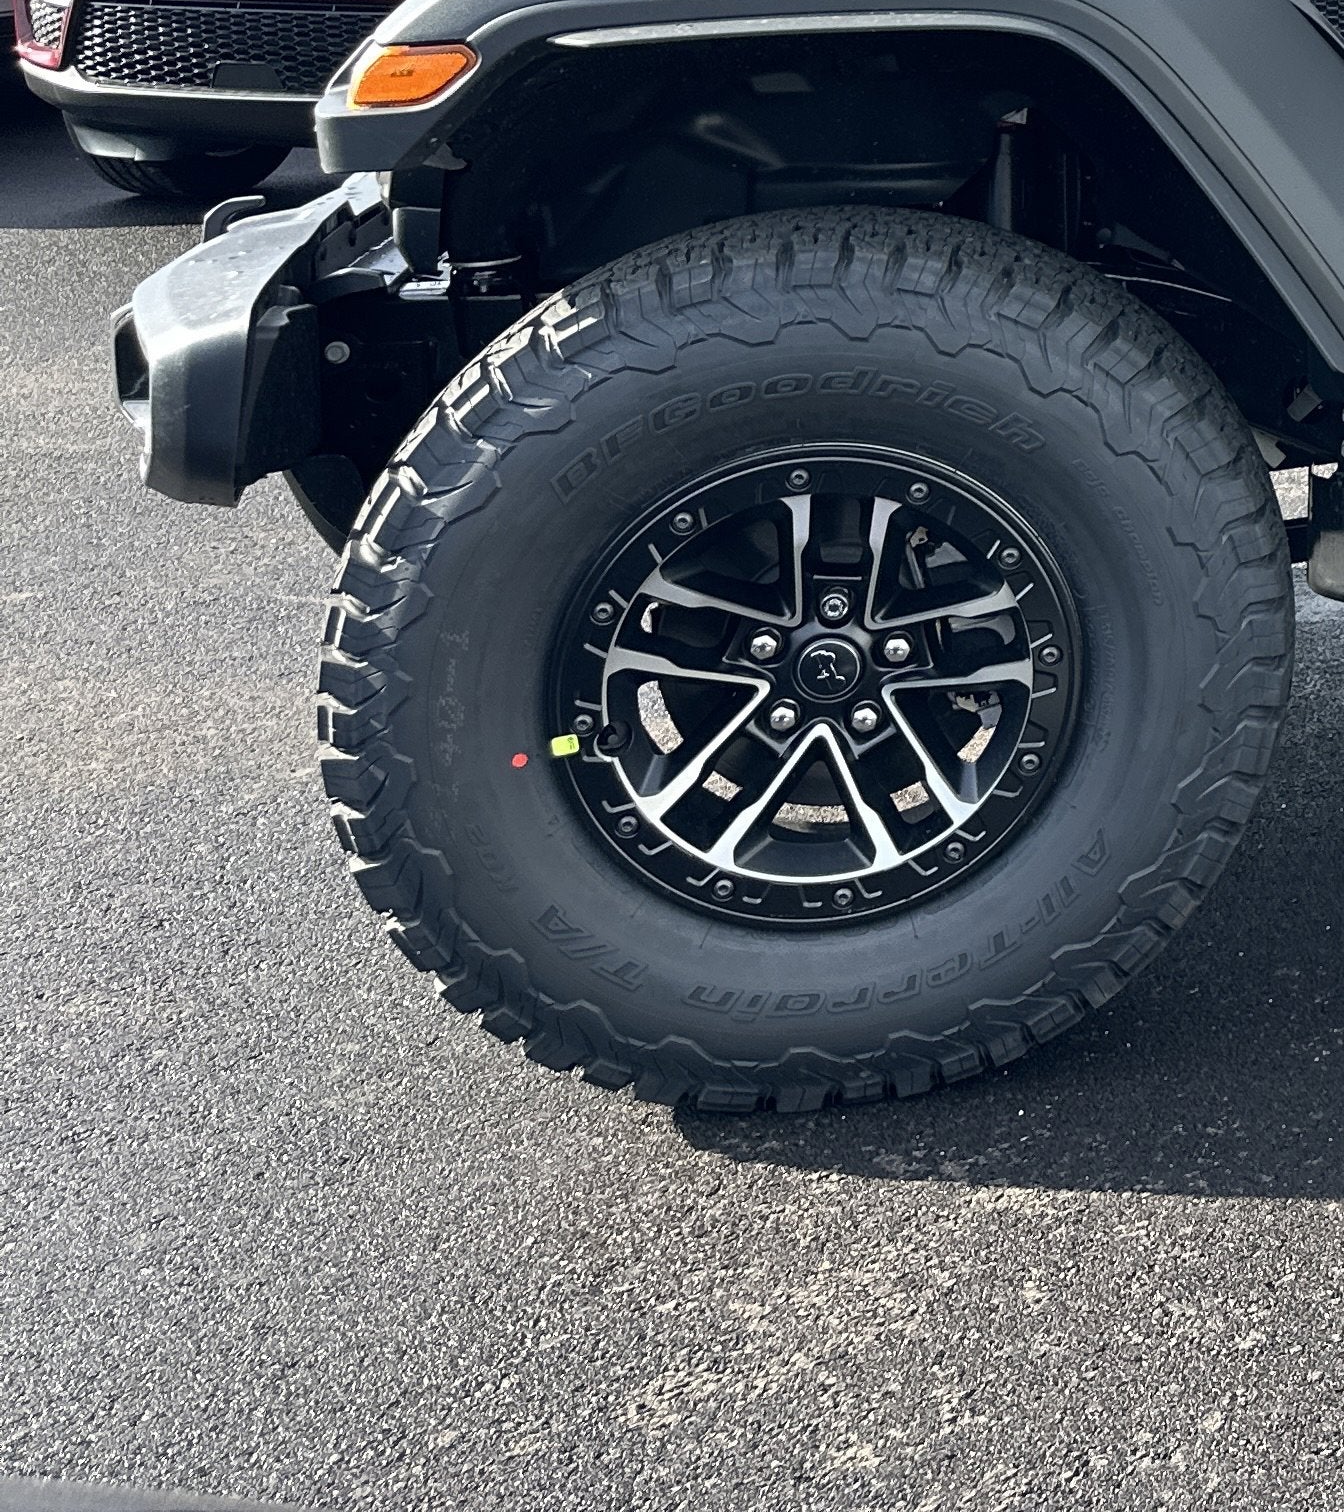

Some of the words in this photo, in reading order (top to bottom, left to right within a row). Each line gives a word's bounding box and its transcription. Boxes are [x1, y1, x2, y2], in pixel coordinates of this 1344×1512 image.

[549, 365, 1047, 506] BFGoodrich
[528, 903, 650, 993] T/A
[680, 827, 1110, 1023] All-Terrain
